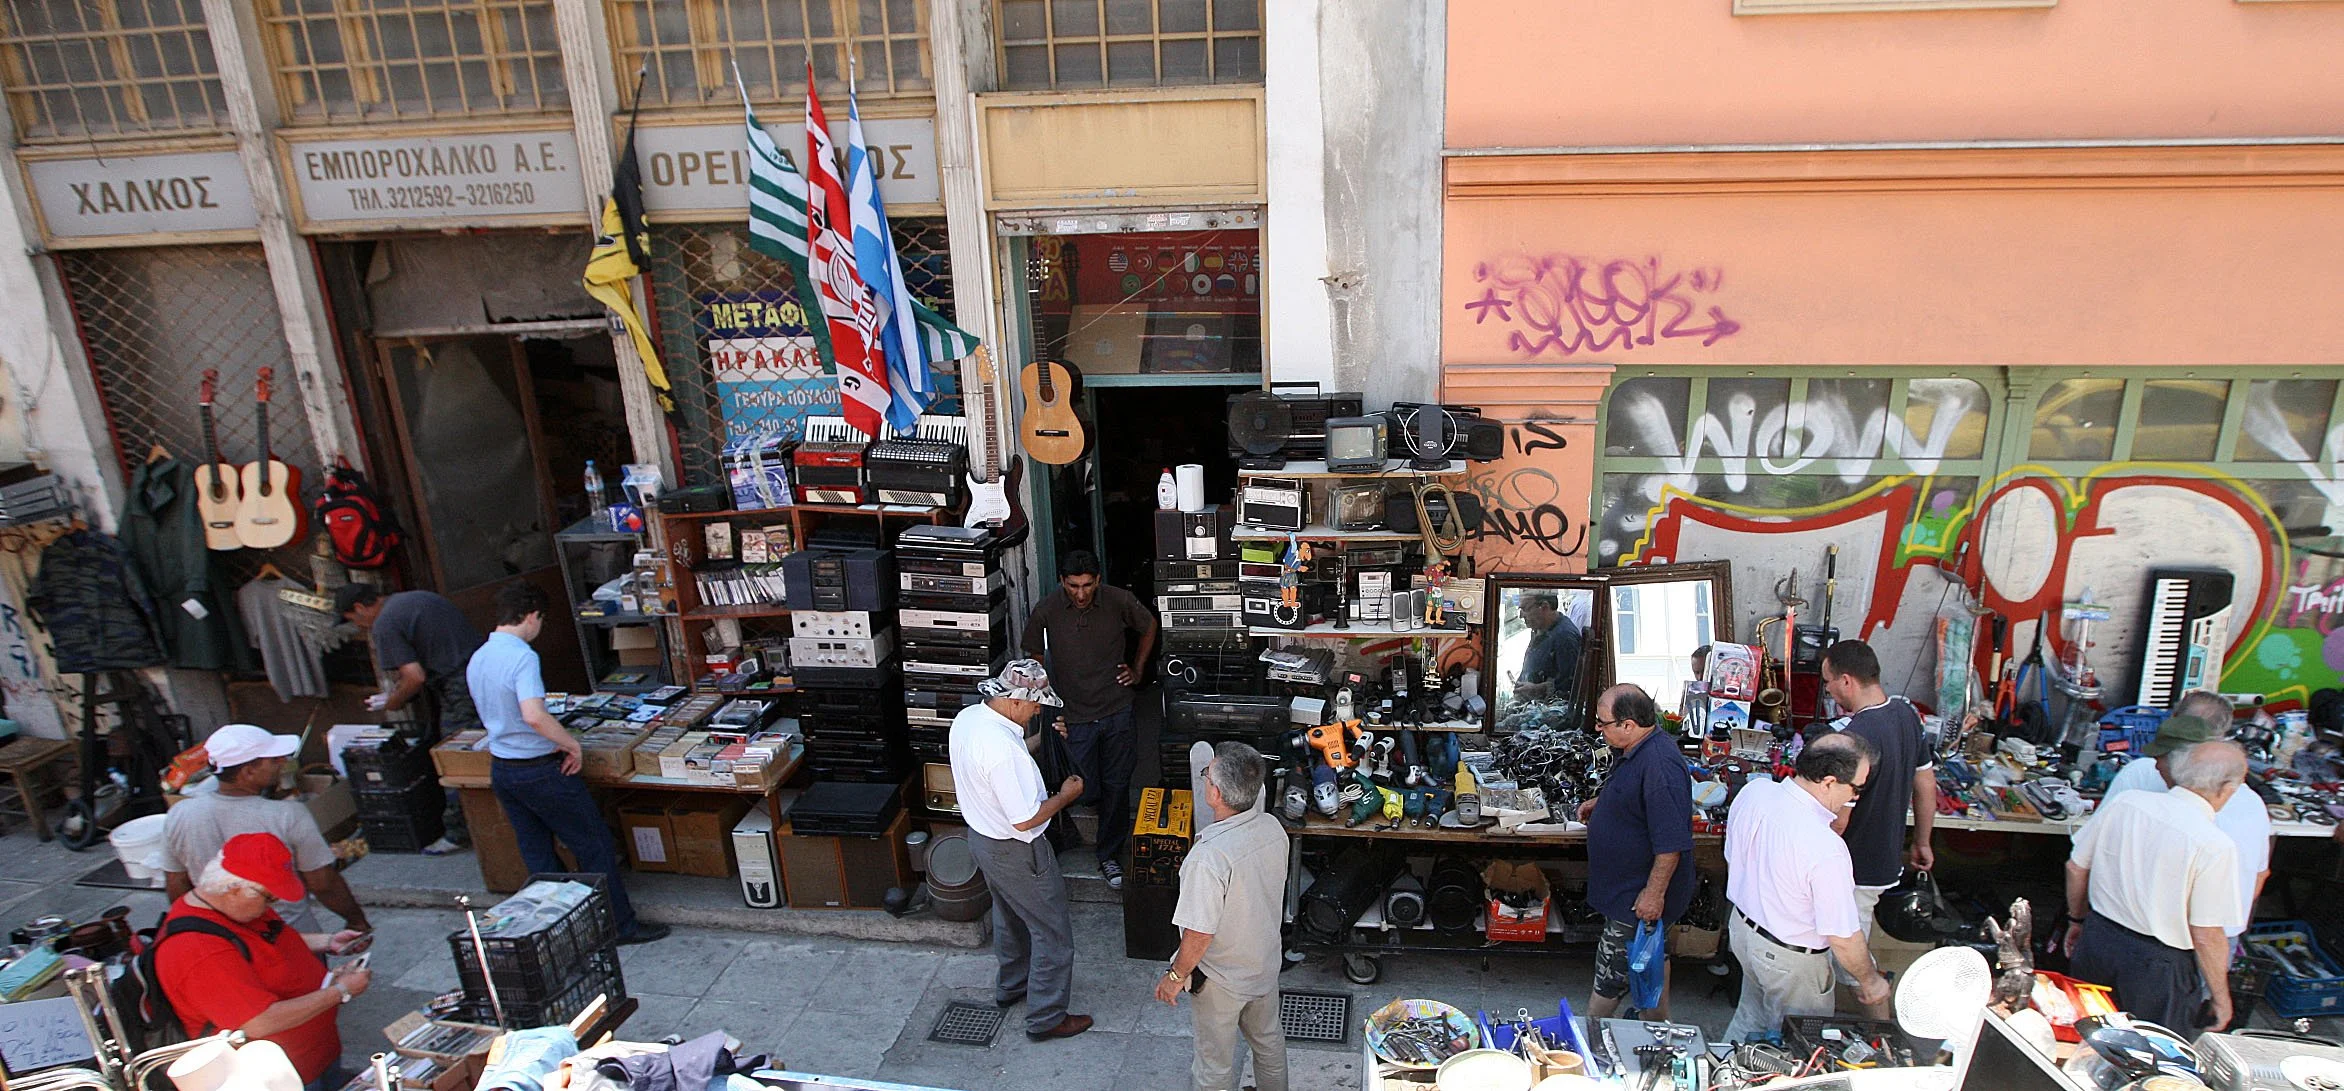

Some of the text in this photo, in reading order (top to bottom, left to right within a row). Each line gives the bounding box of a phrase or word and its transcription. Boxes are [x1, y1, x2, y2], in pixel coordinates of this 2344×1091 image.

[304, 141, 566, 181] ΕΜΠΟΡΟΧΑΛΚΟ Α.Ε.
[69, 176, 218, 215] ΧΑΛΚΟΣ
[348, 181, 535, 211] ΤΗΛ.3212592-3216250
